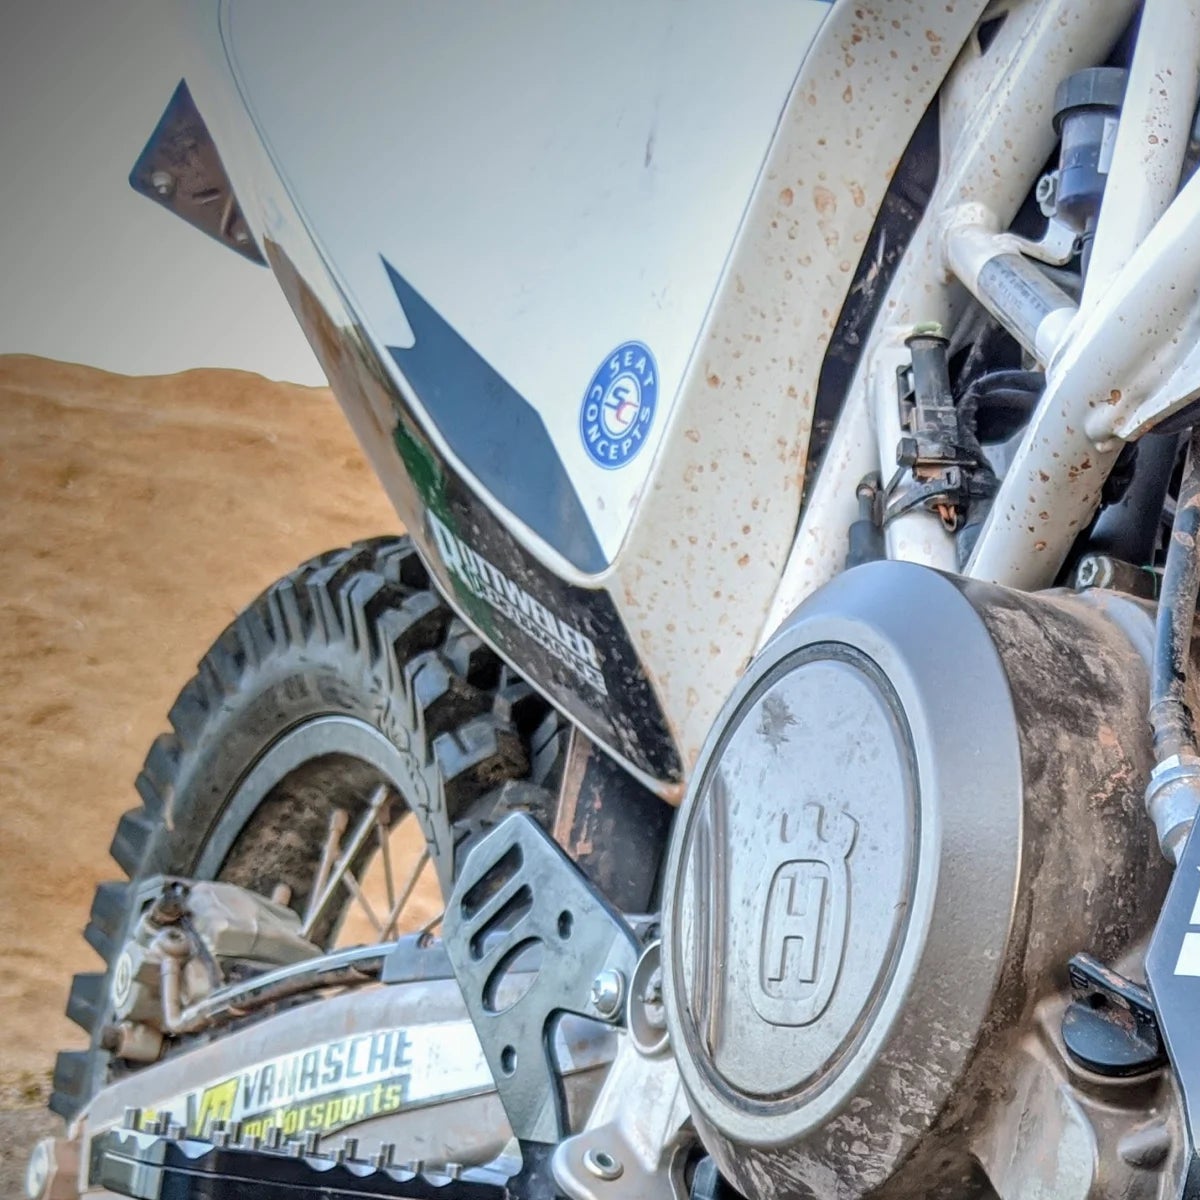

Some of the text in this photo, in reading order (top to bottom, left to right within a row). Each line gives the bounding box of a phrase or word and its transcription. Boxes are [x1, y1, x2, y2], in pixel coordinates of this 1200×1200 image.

[609, 351, 654, 388] SEAT
[586, 384, 651, 460] CONCEPTS
[242, 1031, 414, 1110] VANASCHE
